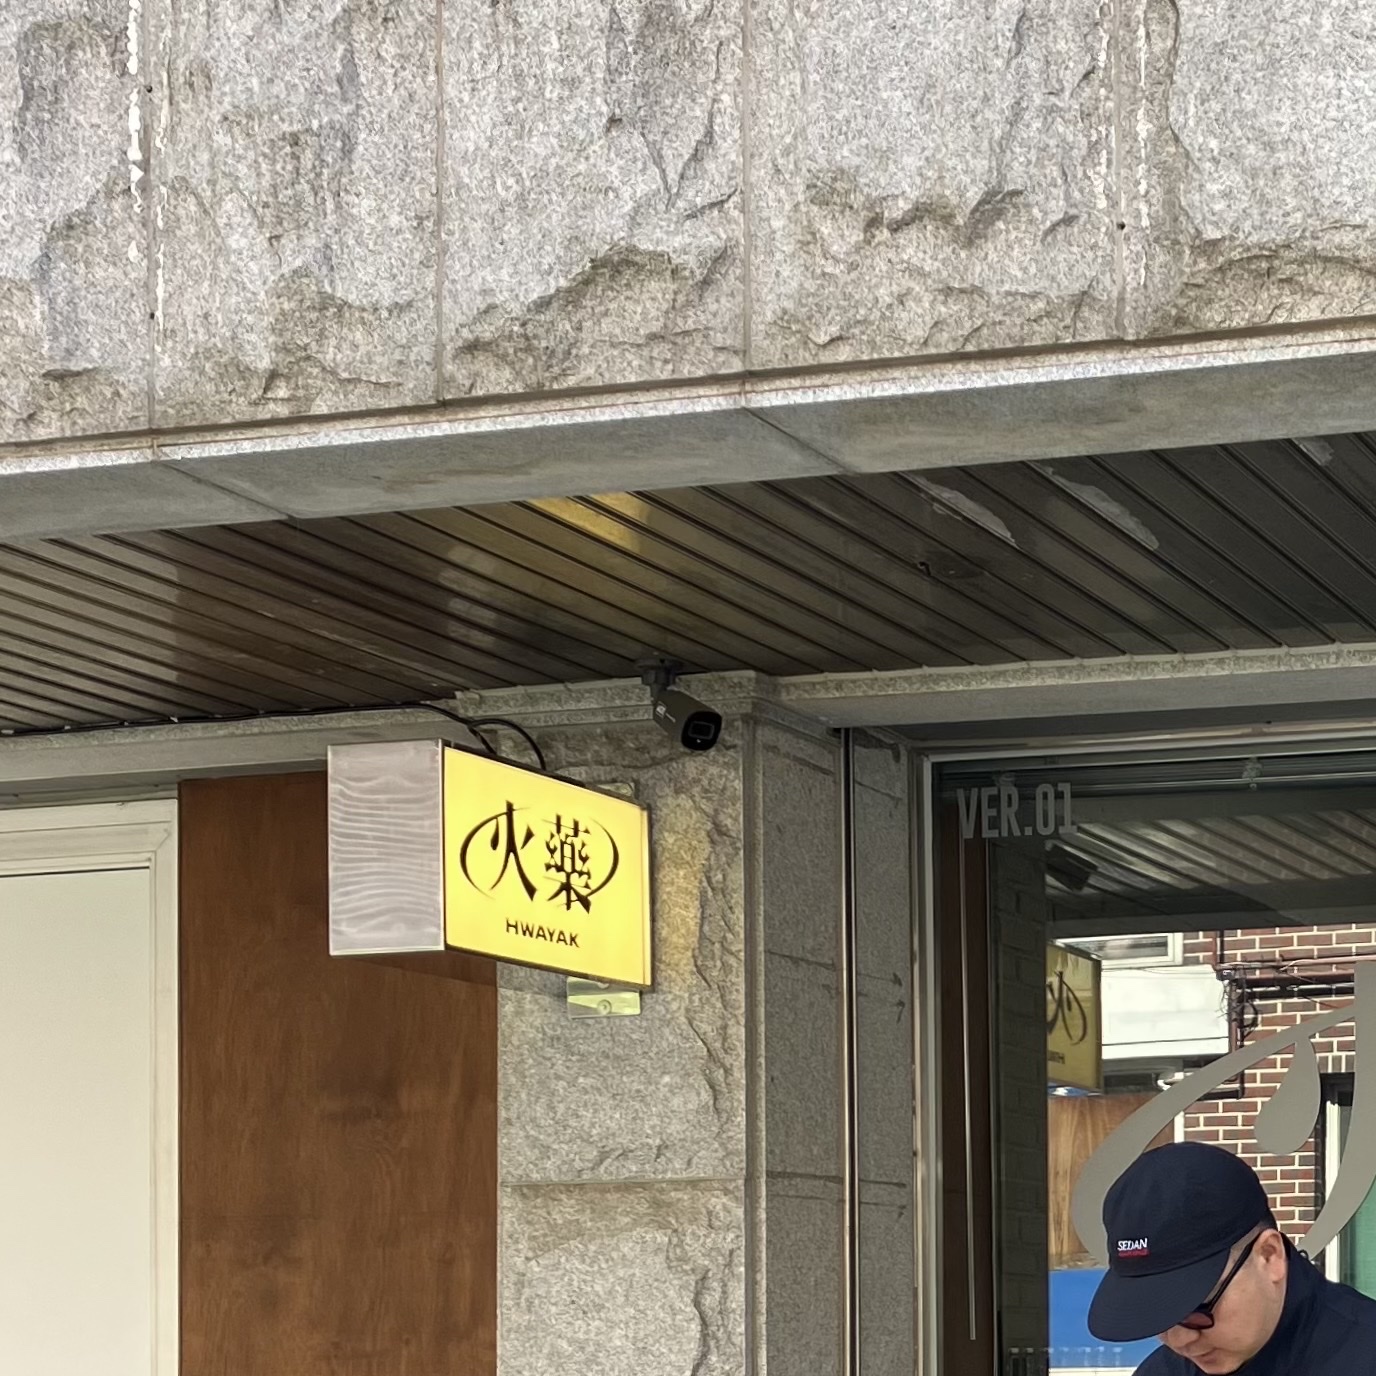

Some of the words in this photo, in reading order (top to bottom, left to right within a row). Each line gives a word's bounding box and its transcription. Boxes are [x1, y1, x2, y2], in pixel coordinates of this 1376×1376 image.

[956, 781, 1080, 840] VER.01
[505, 917, 580, 949] HWAYAK
[1117, 1237, 1148, 1251] SEDAN
